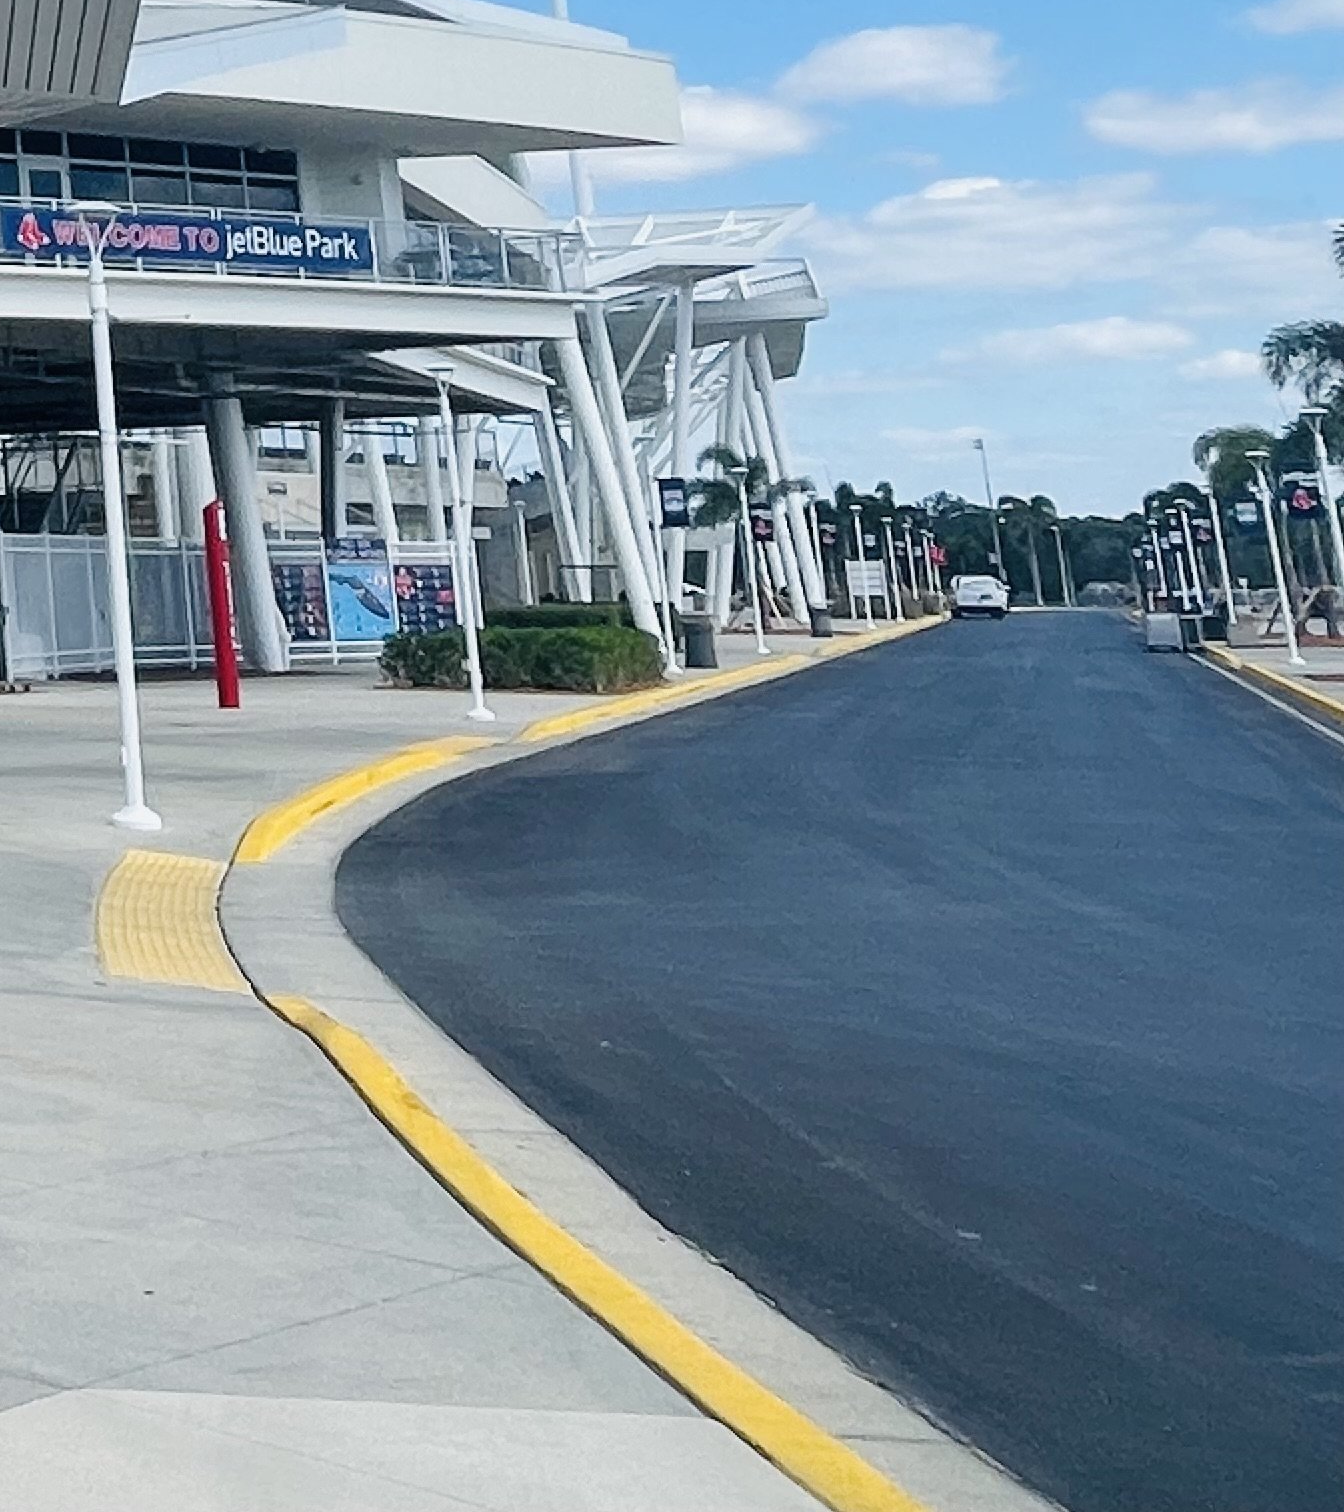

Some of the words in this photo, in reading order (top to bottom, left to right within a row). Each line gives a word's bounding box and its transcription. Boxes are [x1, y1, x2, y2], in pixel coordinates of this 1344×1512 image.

[52, 218, 182, 251] WELCOME
[182, 226, 220, 254] TO
[224, 224, 303, 260] jetBlue
[304, 228, 359, 261] Park
